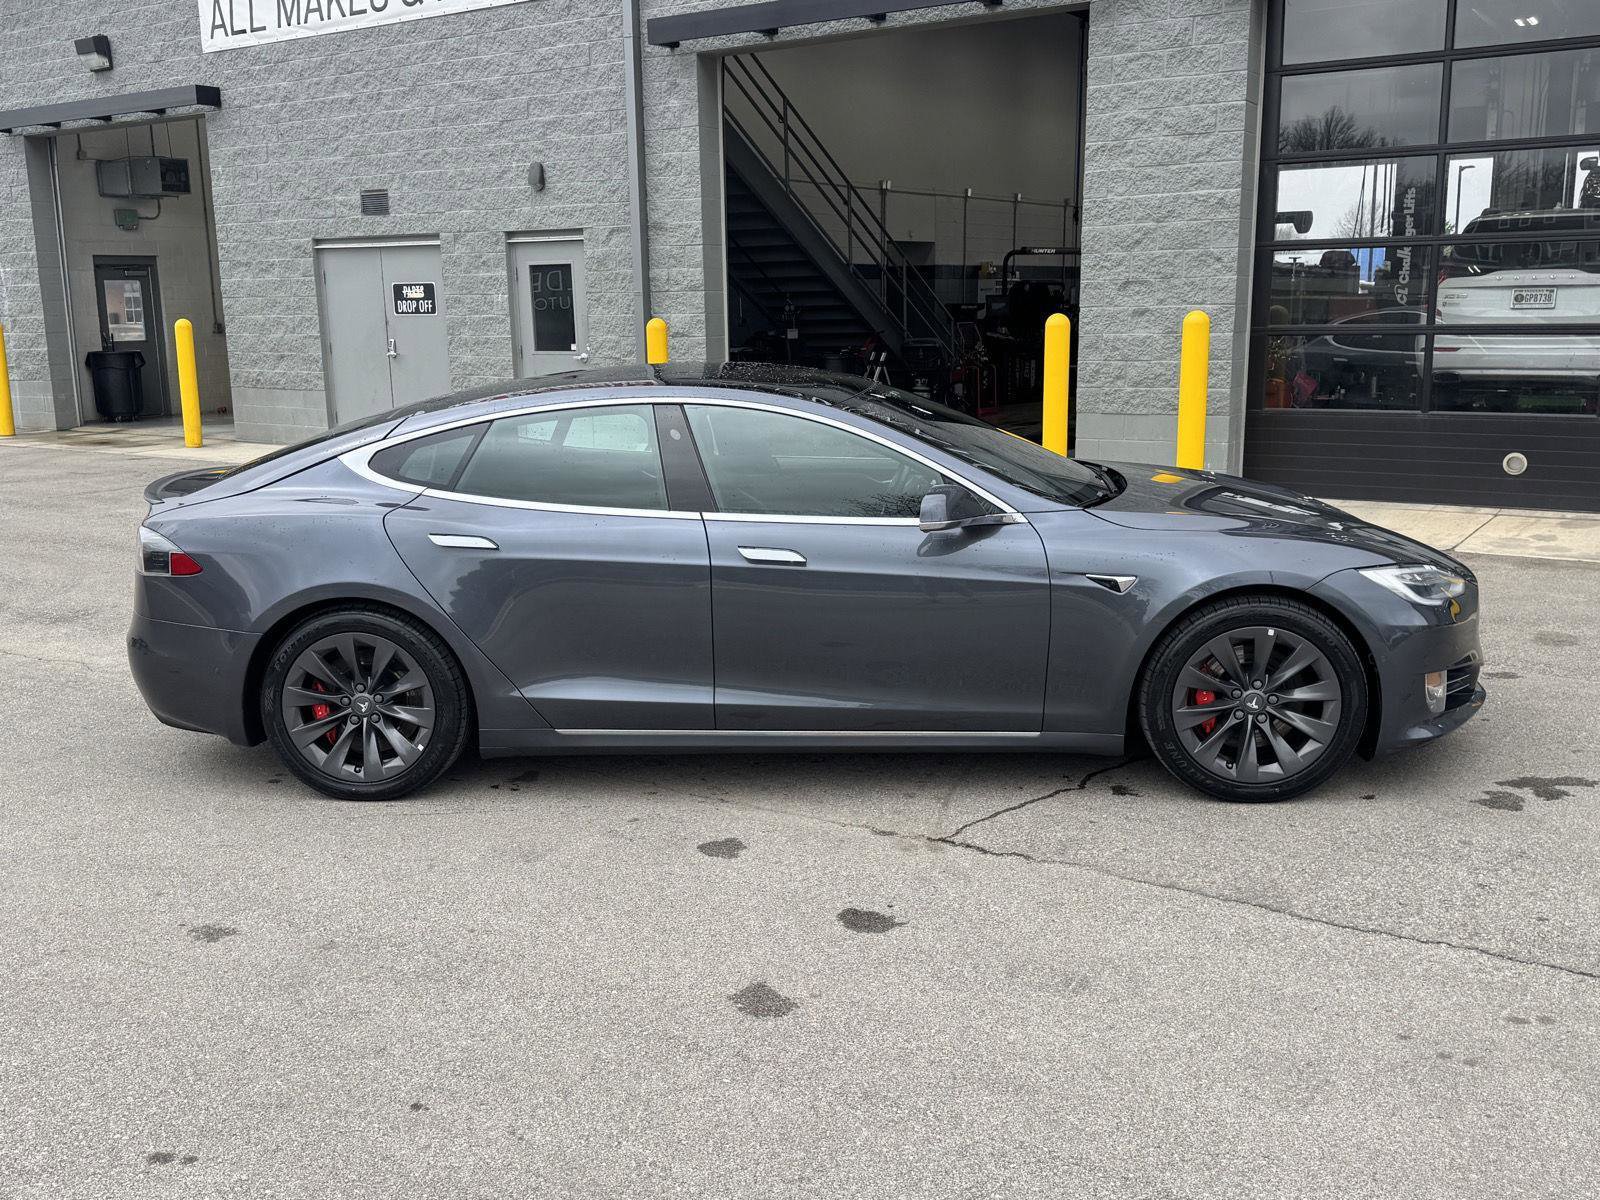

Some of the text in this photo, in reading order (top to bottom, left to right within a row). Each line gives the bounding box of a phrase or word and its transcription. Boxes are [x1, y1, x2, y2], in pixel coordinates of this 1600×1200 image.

[210, 0, 388, 39] ALL MAK
[1403, 187, 1416, 214] Lifts
[1397, 215, 1416, 285] Challeger
[397, 300, 433, 312] DROP OFF
